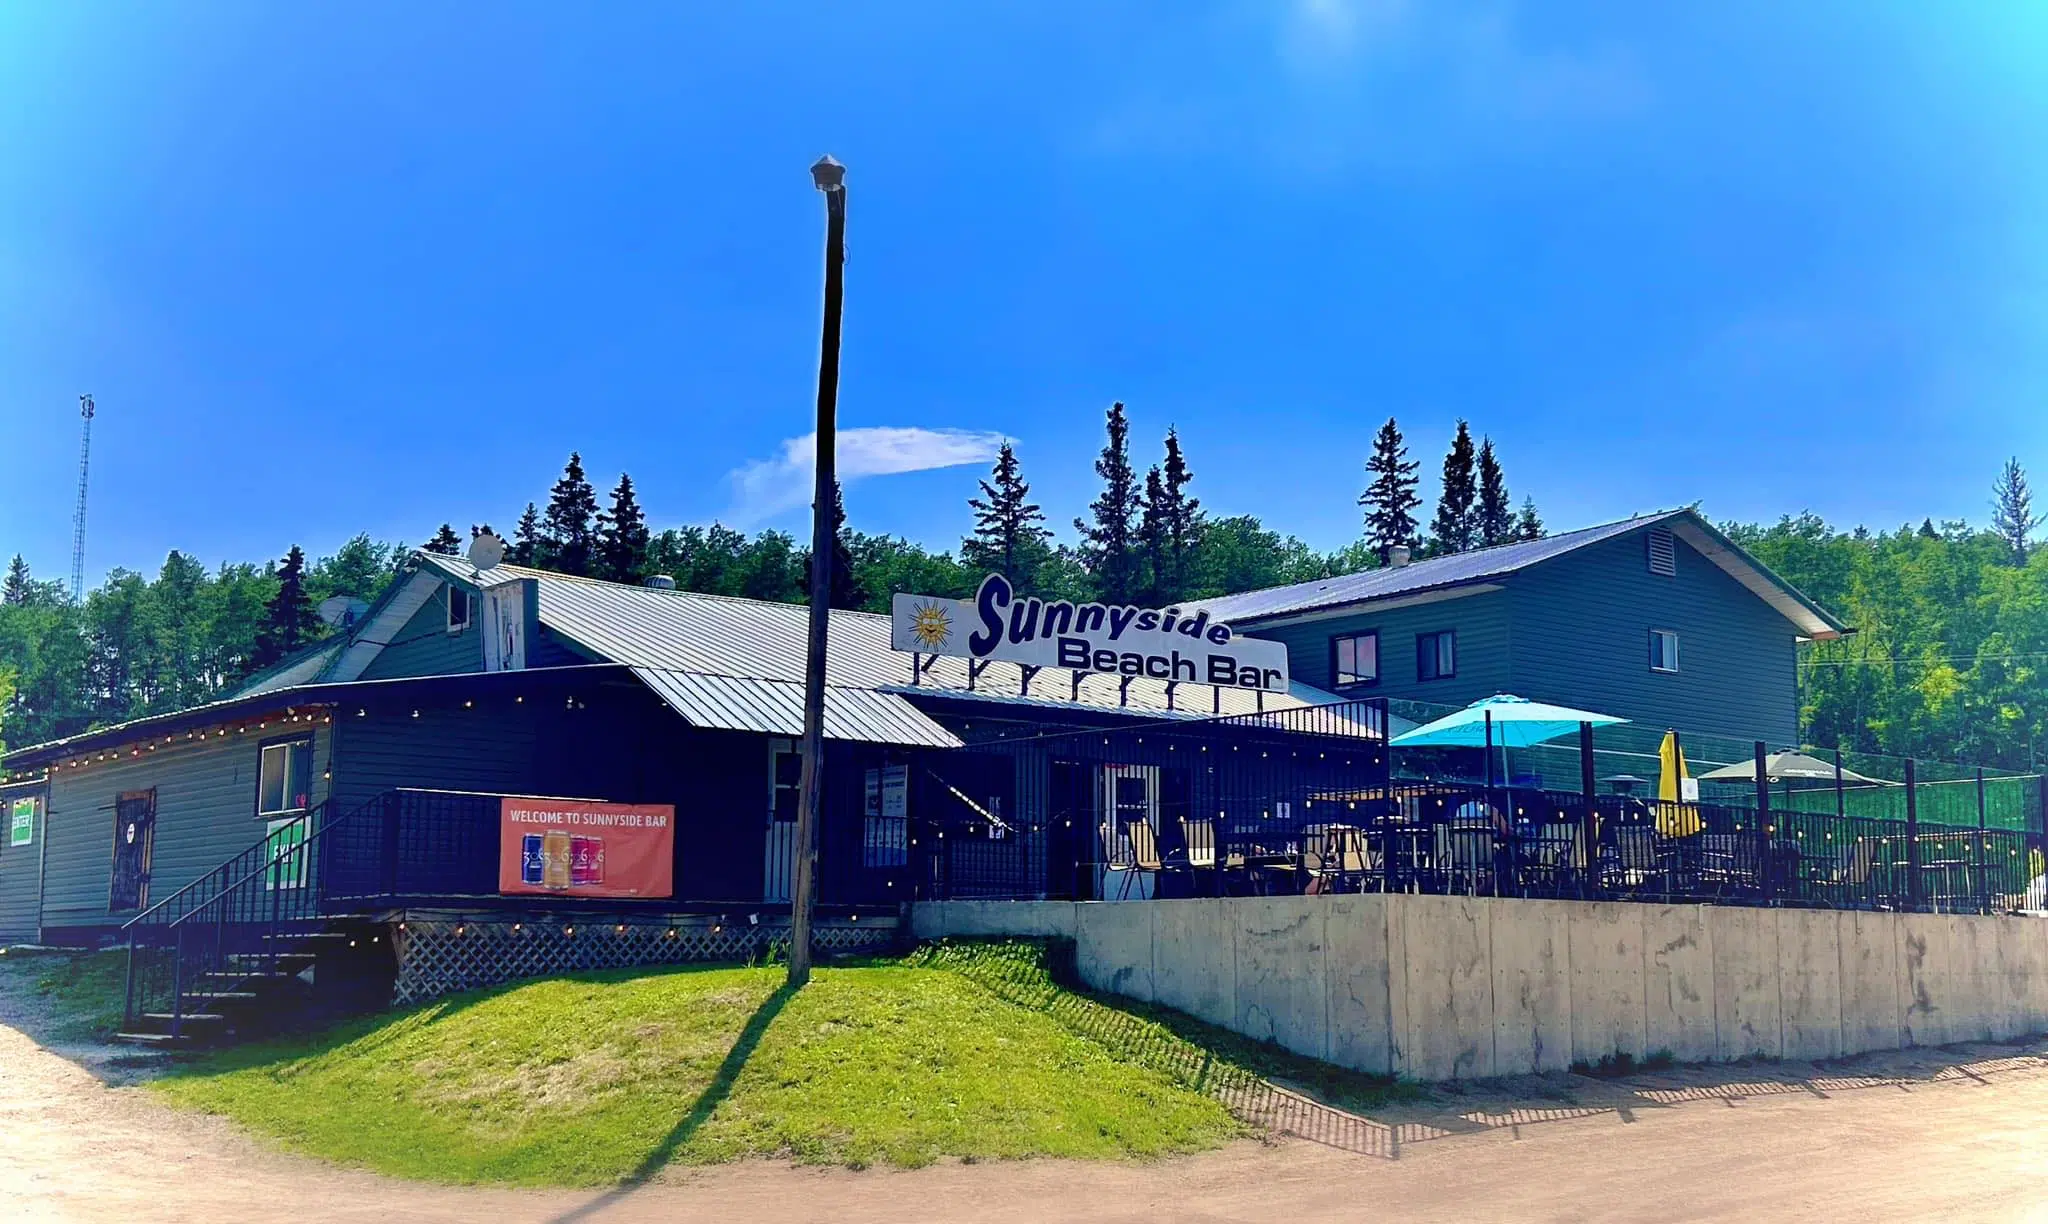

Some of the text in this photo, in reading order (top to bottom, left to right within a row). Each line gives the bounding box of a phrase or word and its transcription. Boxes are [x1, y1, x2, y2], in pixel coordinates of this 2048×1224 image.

[969, 573, 1231, 657] Sunnyside
[1058, 637, 1282, 690] Beach Bar
[510, 809, 668, 828] WELCOME TO SUNNYSIDE BAR
